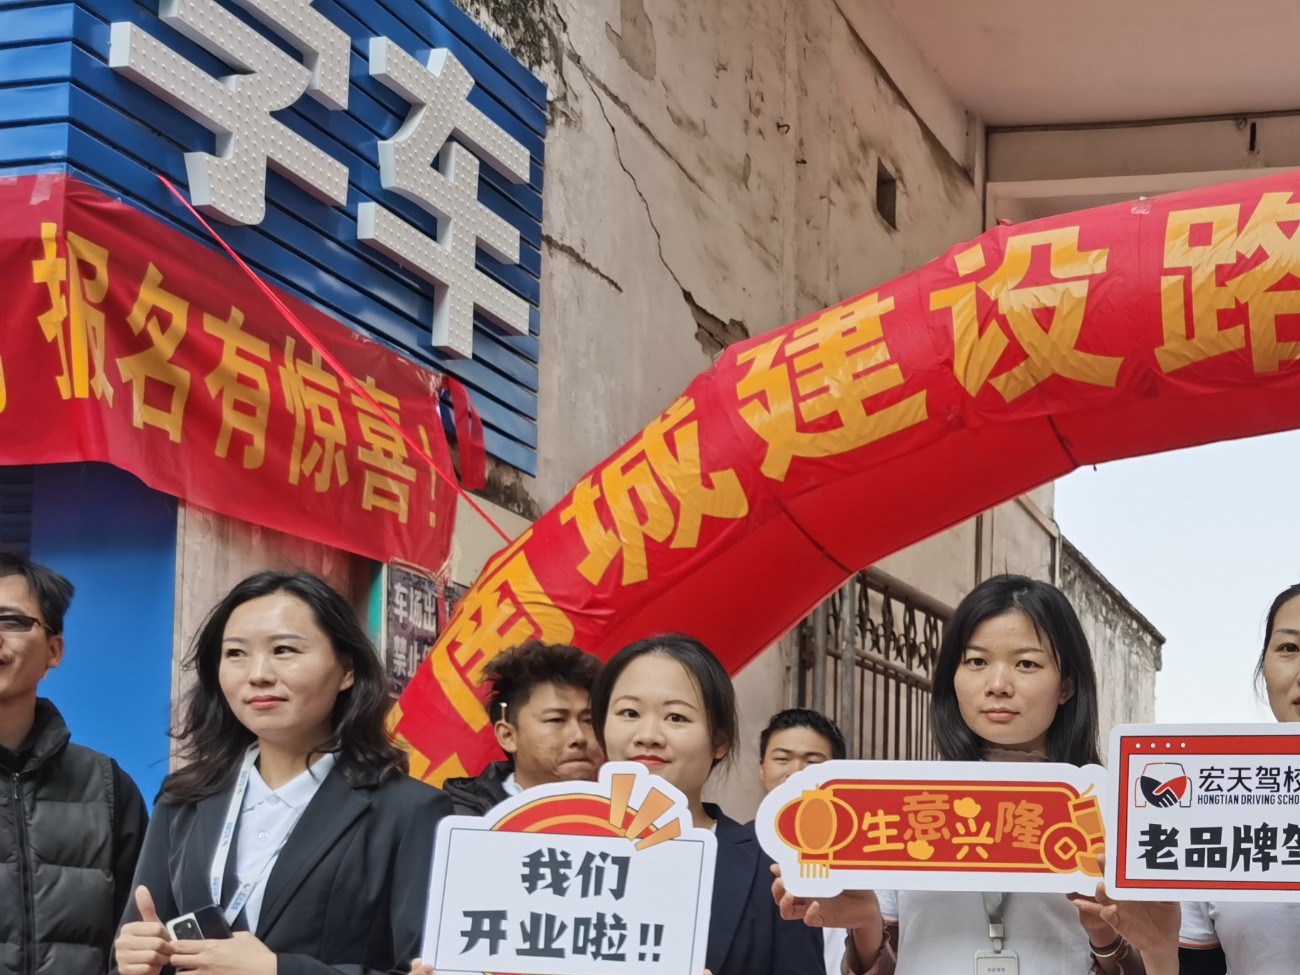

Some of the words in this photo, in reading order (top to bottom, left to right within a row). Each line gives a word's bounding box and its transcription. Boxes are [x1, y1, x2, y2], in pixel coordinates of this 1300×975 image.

[107, 0, 530, 360] 学车
[0, 222, 437, 528] 报名有惊喜!
[393, 582, 450, 634] 车场出
[861, 791, 1045, 860] 生意兴隆
[1197, 794, 1240, 805] HONGTIAN
[1241, 794, 1276, 805] DRIVING
[520, 847, 632, 901] 我们
[459, 909, 665, 962] 开业啦!!
